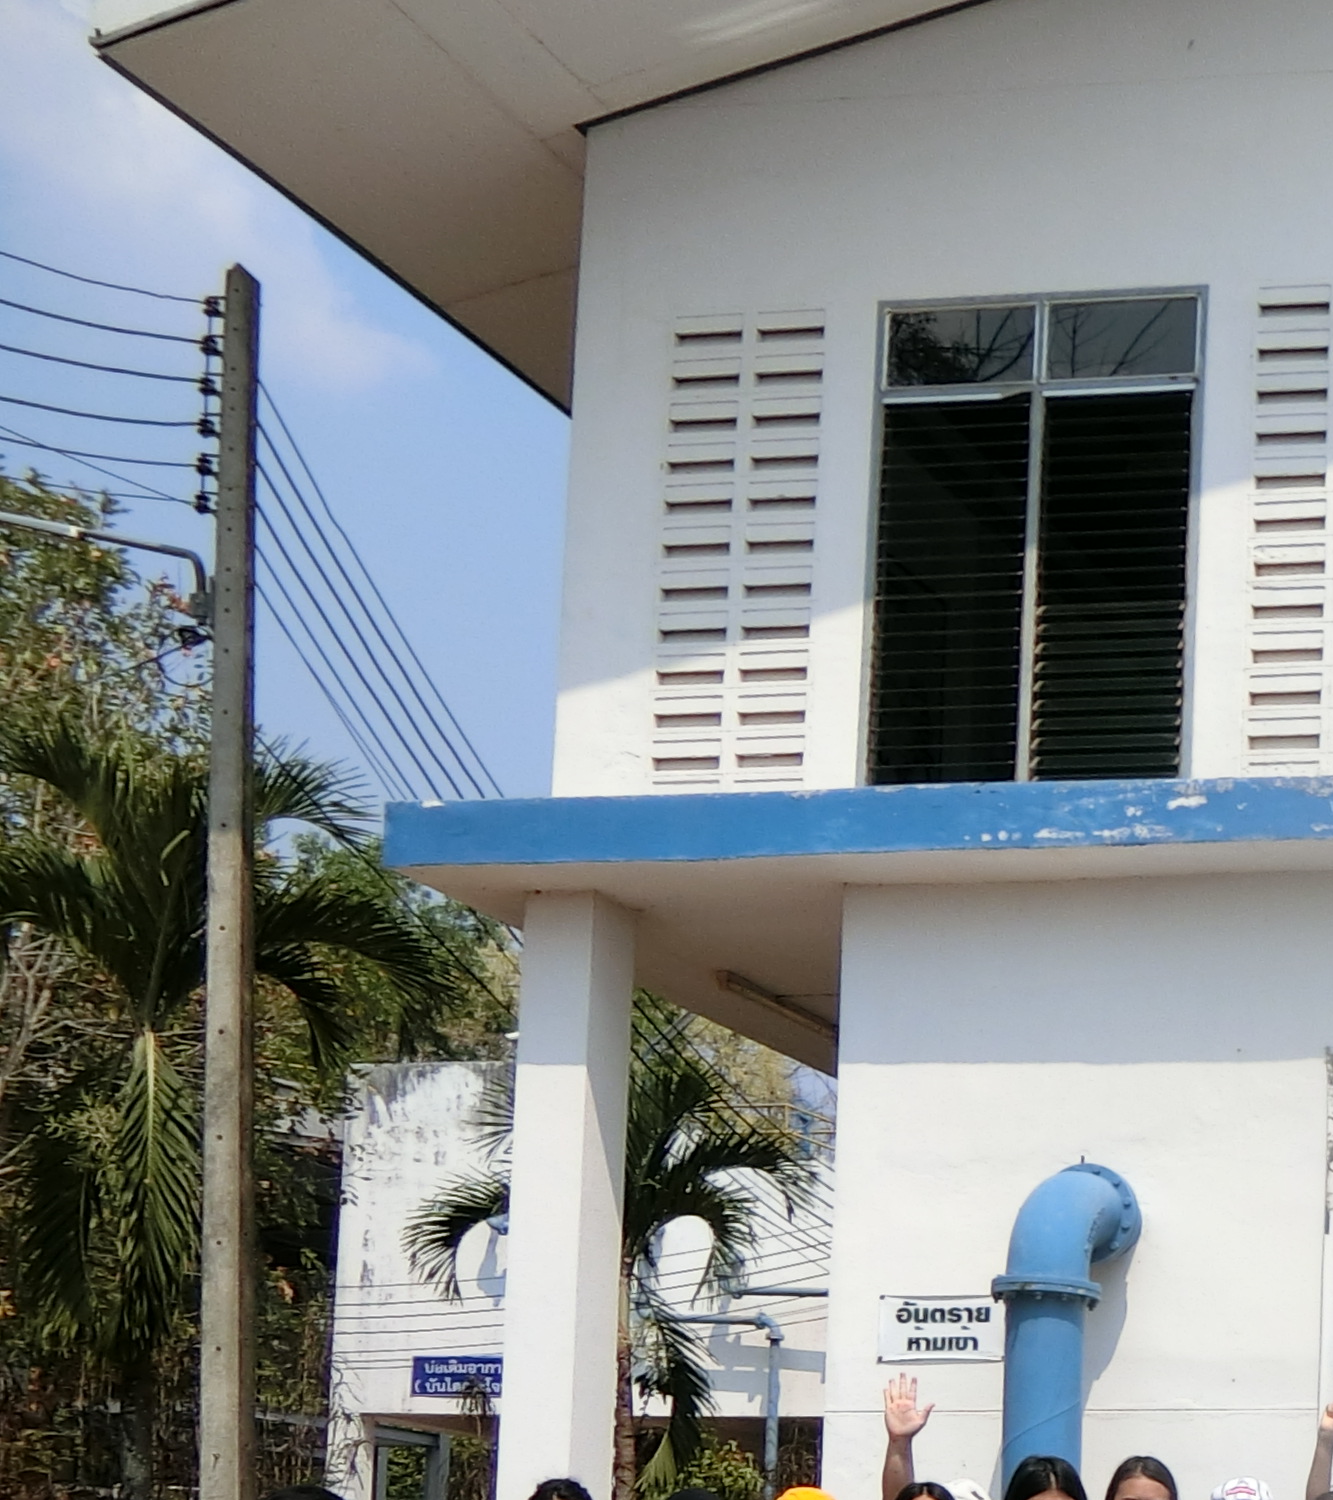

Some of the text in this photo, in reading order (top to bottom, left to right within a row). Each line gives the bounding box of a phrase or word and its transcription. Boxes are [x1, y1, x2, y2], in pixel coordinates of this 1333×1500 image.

[896, 1301, 991, 1324] อันตราย
[907, 1325, 979, 1351] ห้ามเข้า
